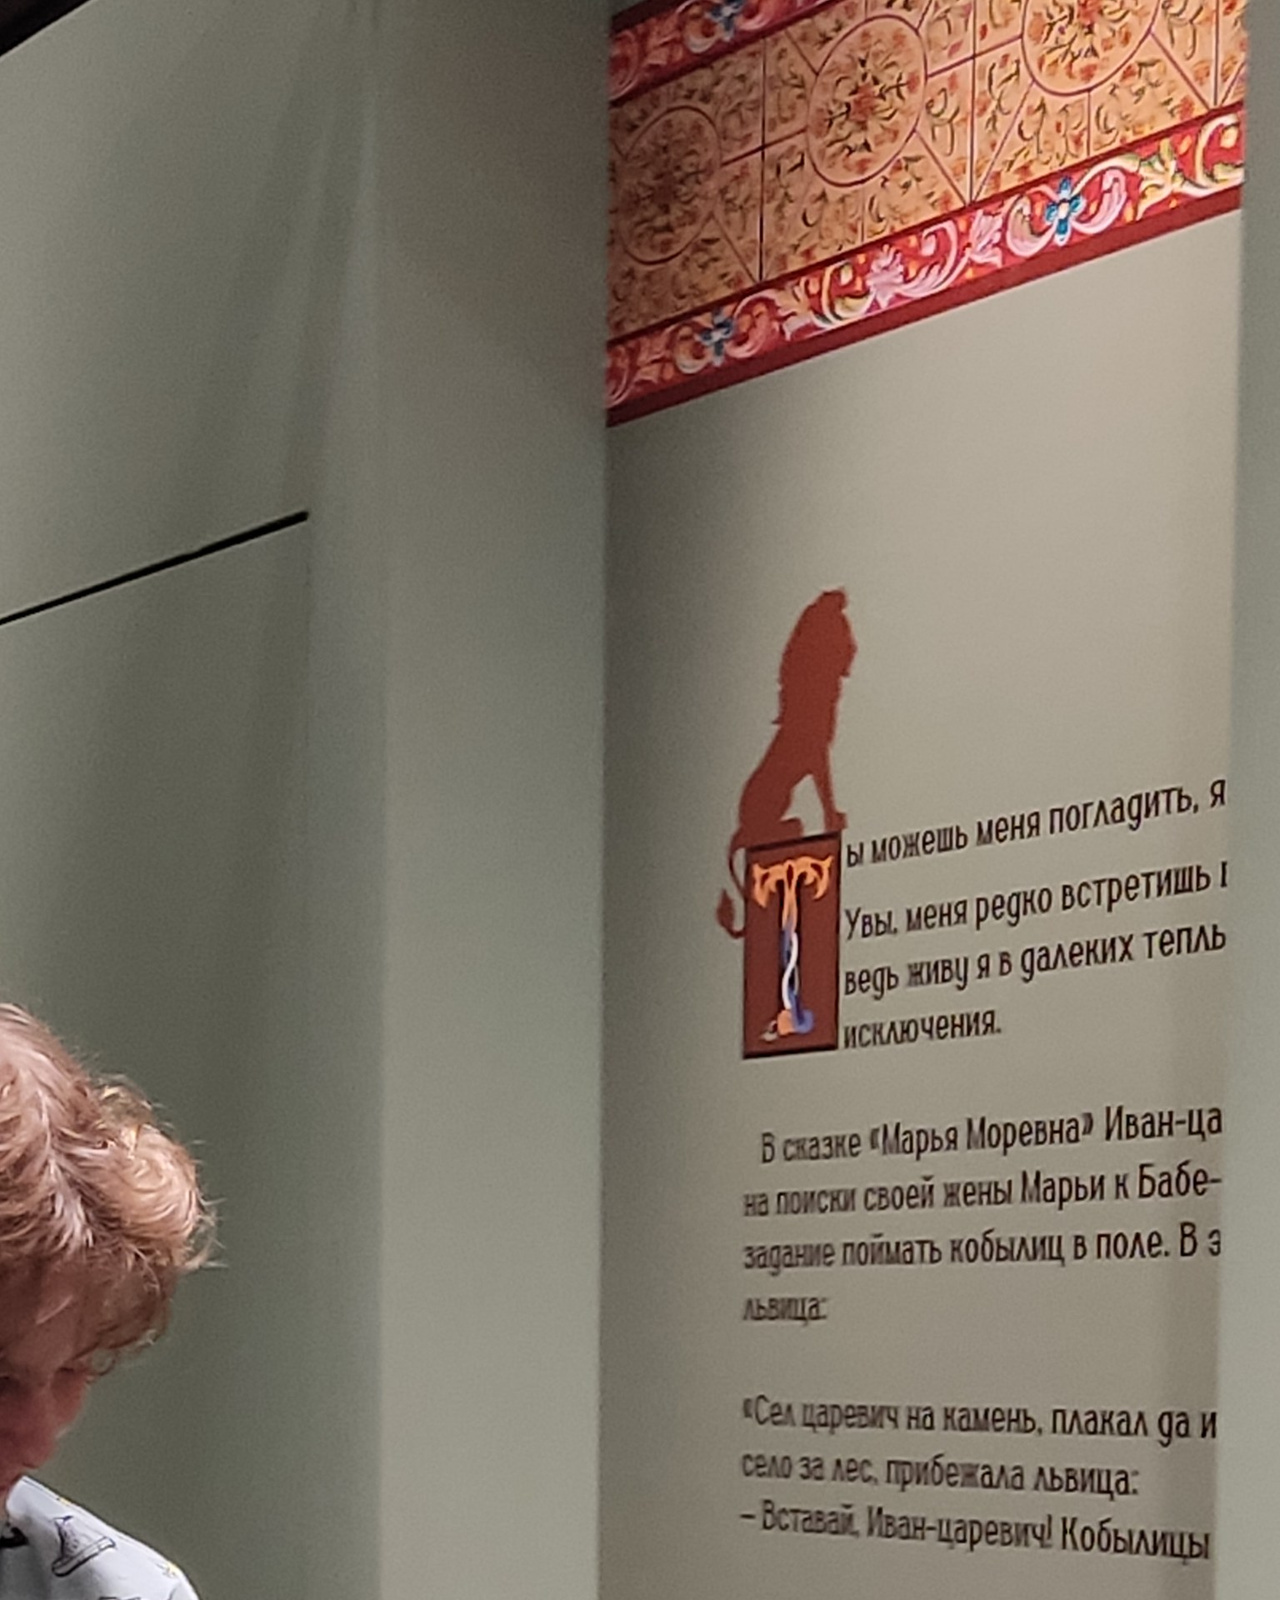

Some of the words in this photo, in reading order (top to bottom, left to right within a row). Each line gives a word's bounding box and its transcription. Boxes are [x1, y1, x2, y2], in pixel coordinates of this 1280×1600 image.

[869, 824, 970, 865] можешь
[974, 810, 1042, 848] меня
[904, 898, 969, 934] меня
[974, 886, 1054, 932] редко
[1060, 863, 1212, 915] встретишь
[844, 965, 901, 1002] ведь
[903, 955, 970, 993] живу
[974, 952, 992, 981] я
[996, 950, 1014, 978] в
[1019, 932, 1136, 985] далеких
[843, 1008, 1003, 1050] исключения.
[760, 1131, 777, 1165] В
[781, 1132, 863, 1163] сказке
[867, 1121, 960, 1163] «Марья
[1103, 1104, 1224, 1144] Иван-ца
[742, 1191, 771, 1218] на
[773, 1187, 858, 1216] поиски
[862, 1173, 936, 1213] своей
[940, 1178, 1016, 1209] жены
[1019, 1168, 1107, 1212] Марьи
[1112, 1172, 1131, 1201] к
[742, 1242, 837, 1279] задание
[840, 1231, 944, 1267] поймать
[948, 1226, 1067, 1269] кобылиц
[1069, 1233, 1089, 1261] в
[1092, 1229, 1172, 1261] поле.
[1178, 1220, 1200, 1258] В
[741, 1393, 798, 1428] «Сел
[799, 1402, 901, 1437] царевич
[904, 1405, 937, 1432] на
[1049, 1407, 1151, 1438] плакал
[1156, 1410, 1193, 1449] да
[1198, 1410, 1218, 1440] и
[739, 1453, 795, 1480] село
[796, 1455, 828, 1482] за
[884, 1452, 1027, 1494] прибежала
[865, 1504, 1055, 1554] Иван-царевич!
[1059, 1515, 1214, 1567] Кобылицы
